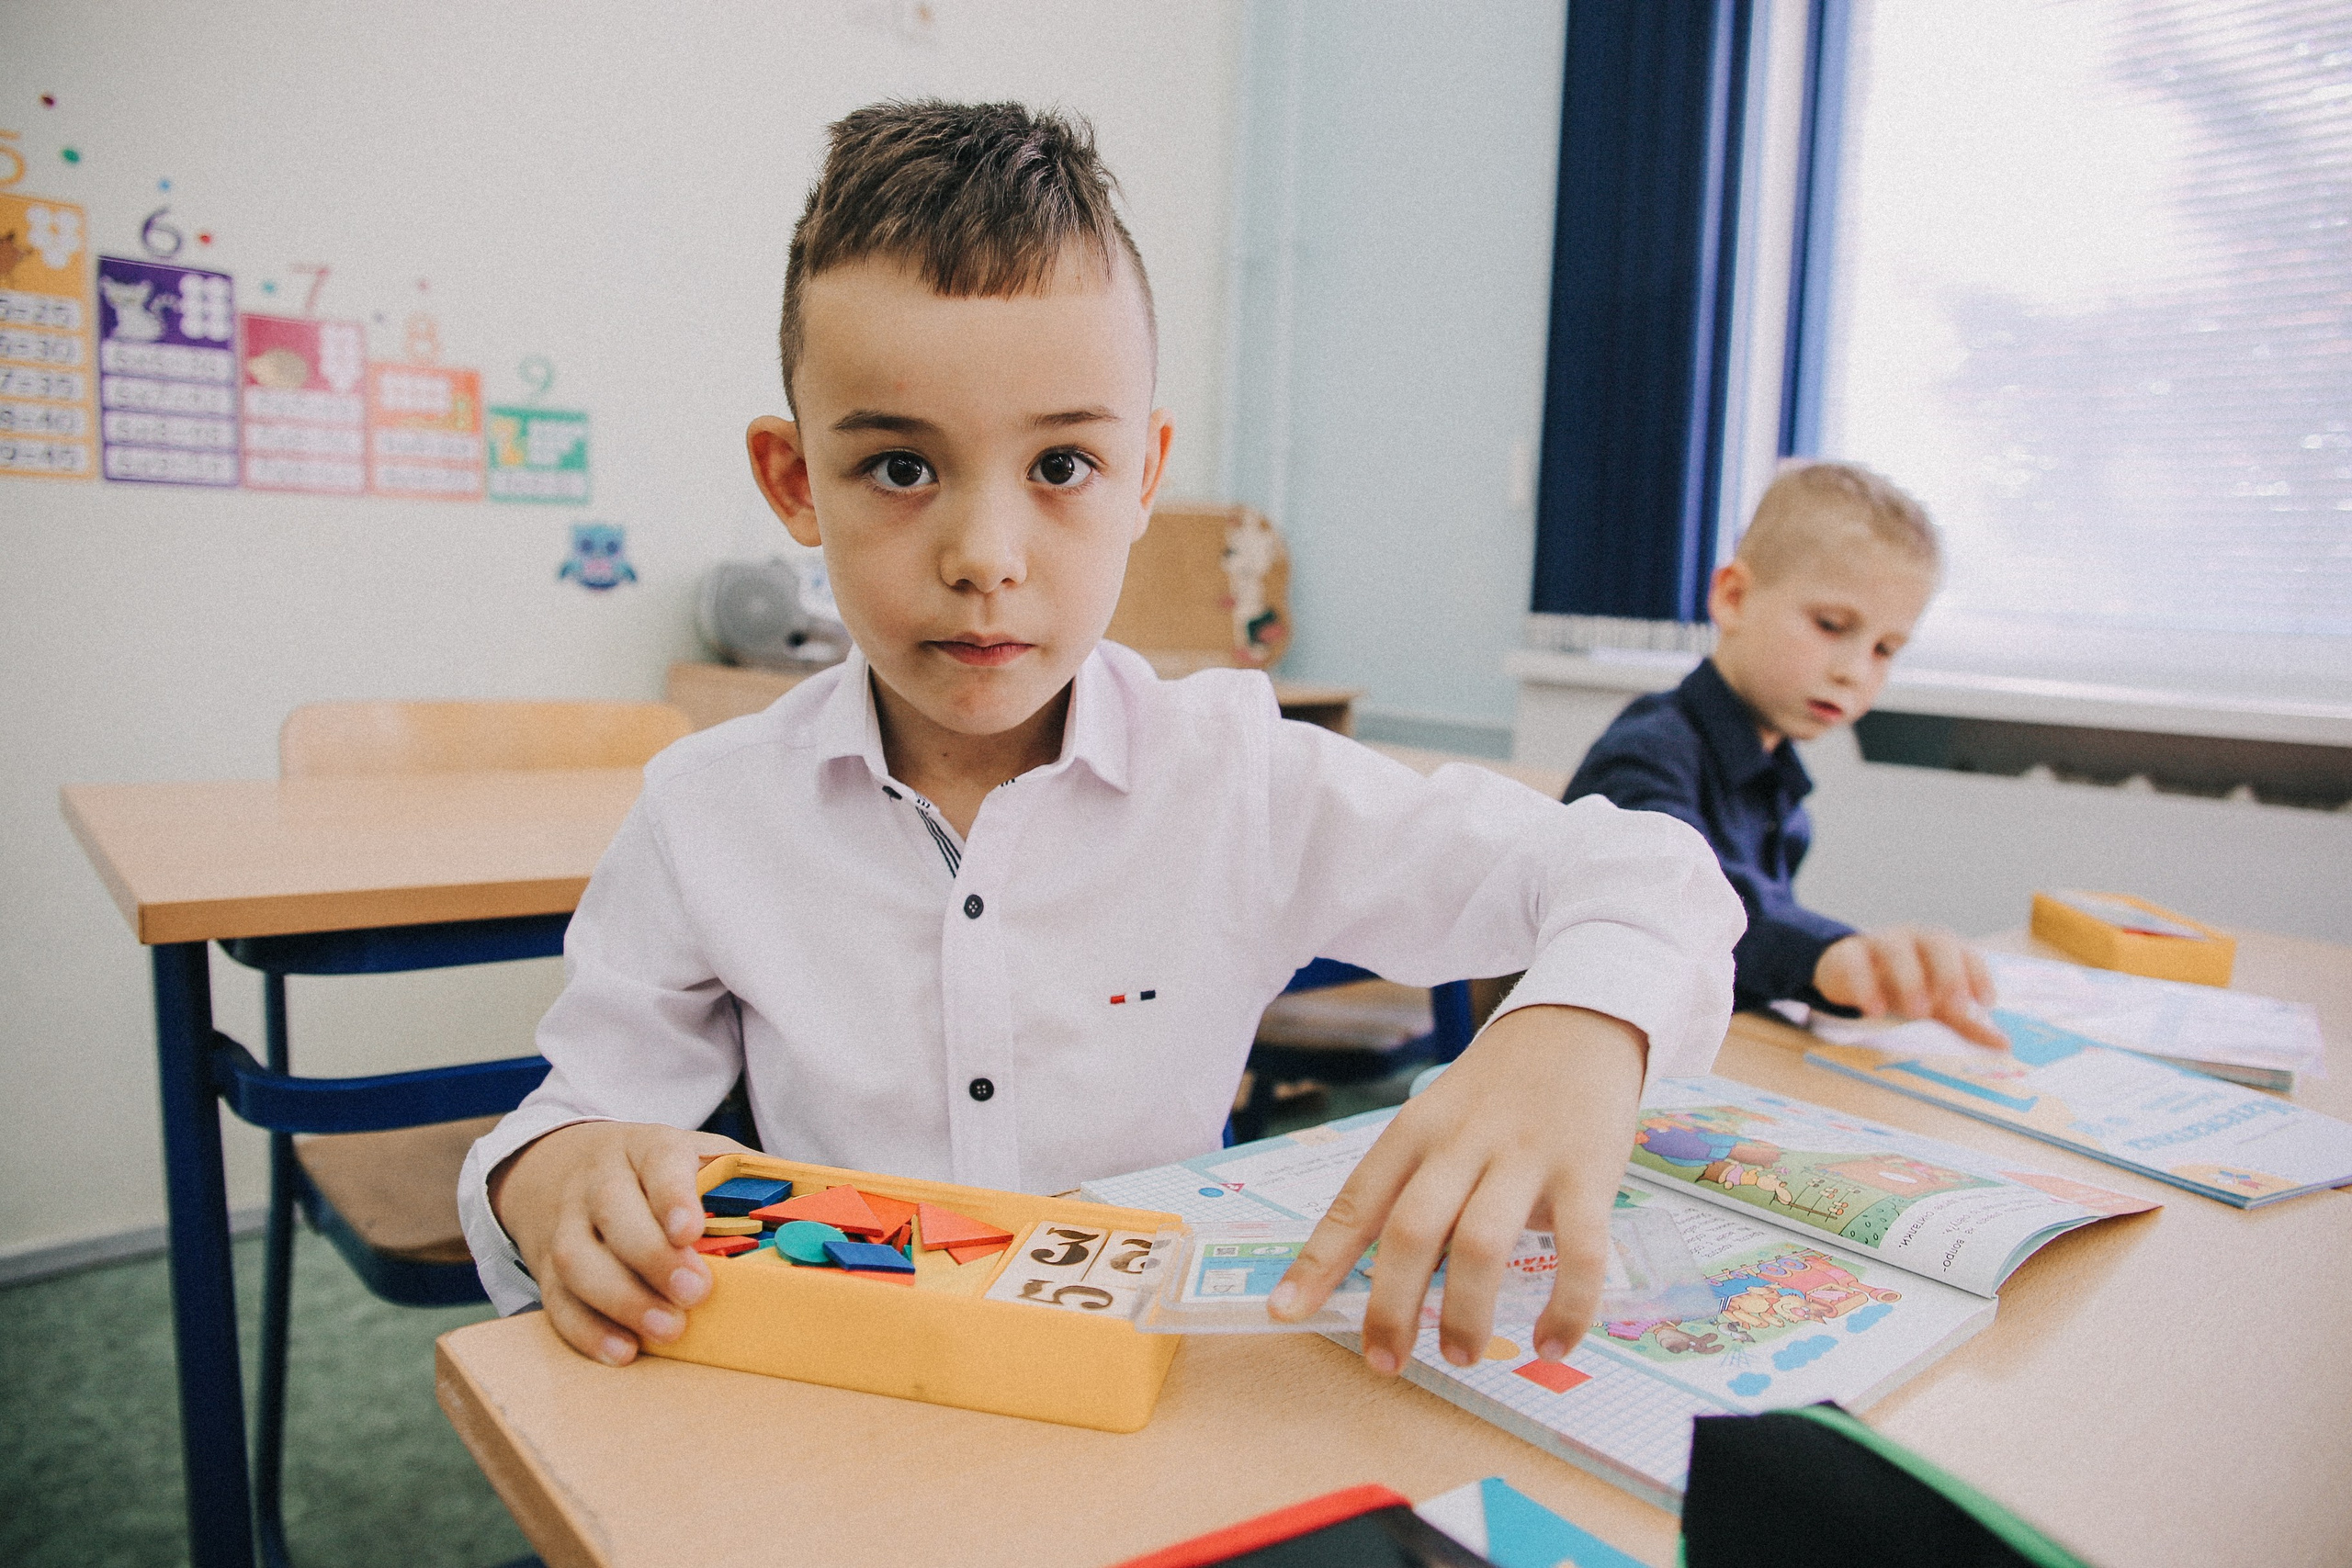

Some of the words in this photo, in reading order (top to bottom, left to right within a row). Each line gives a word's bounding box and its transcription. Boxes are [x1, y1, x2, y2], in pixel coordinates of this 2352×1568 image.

[141, 206, 184, 259] 6
[289, 263, 334, 314] 7
[403, 310, 442, 364] 8
[517, 354, 556, 402] 9
[1030, 1226, 1100, 1267] 3
[1898, 1211, 1934, 1247] считалки.
[1942, 1238, 1965, 1272] вопро-
[1017, 1279, 1114, 1311] 5
